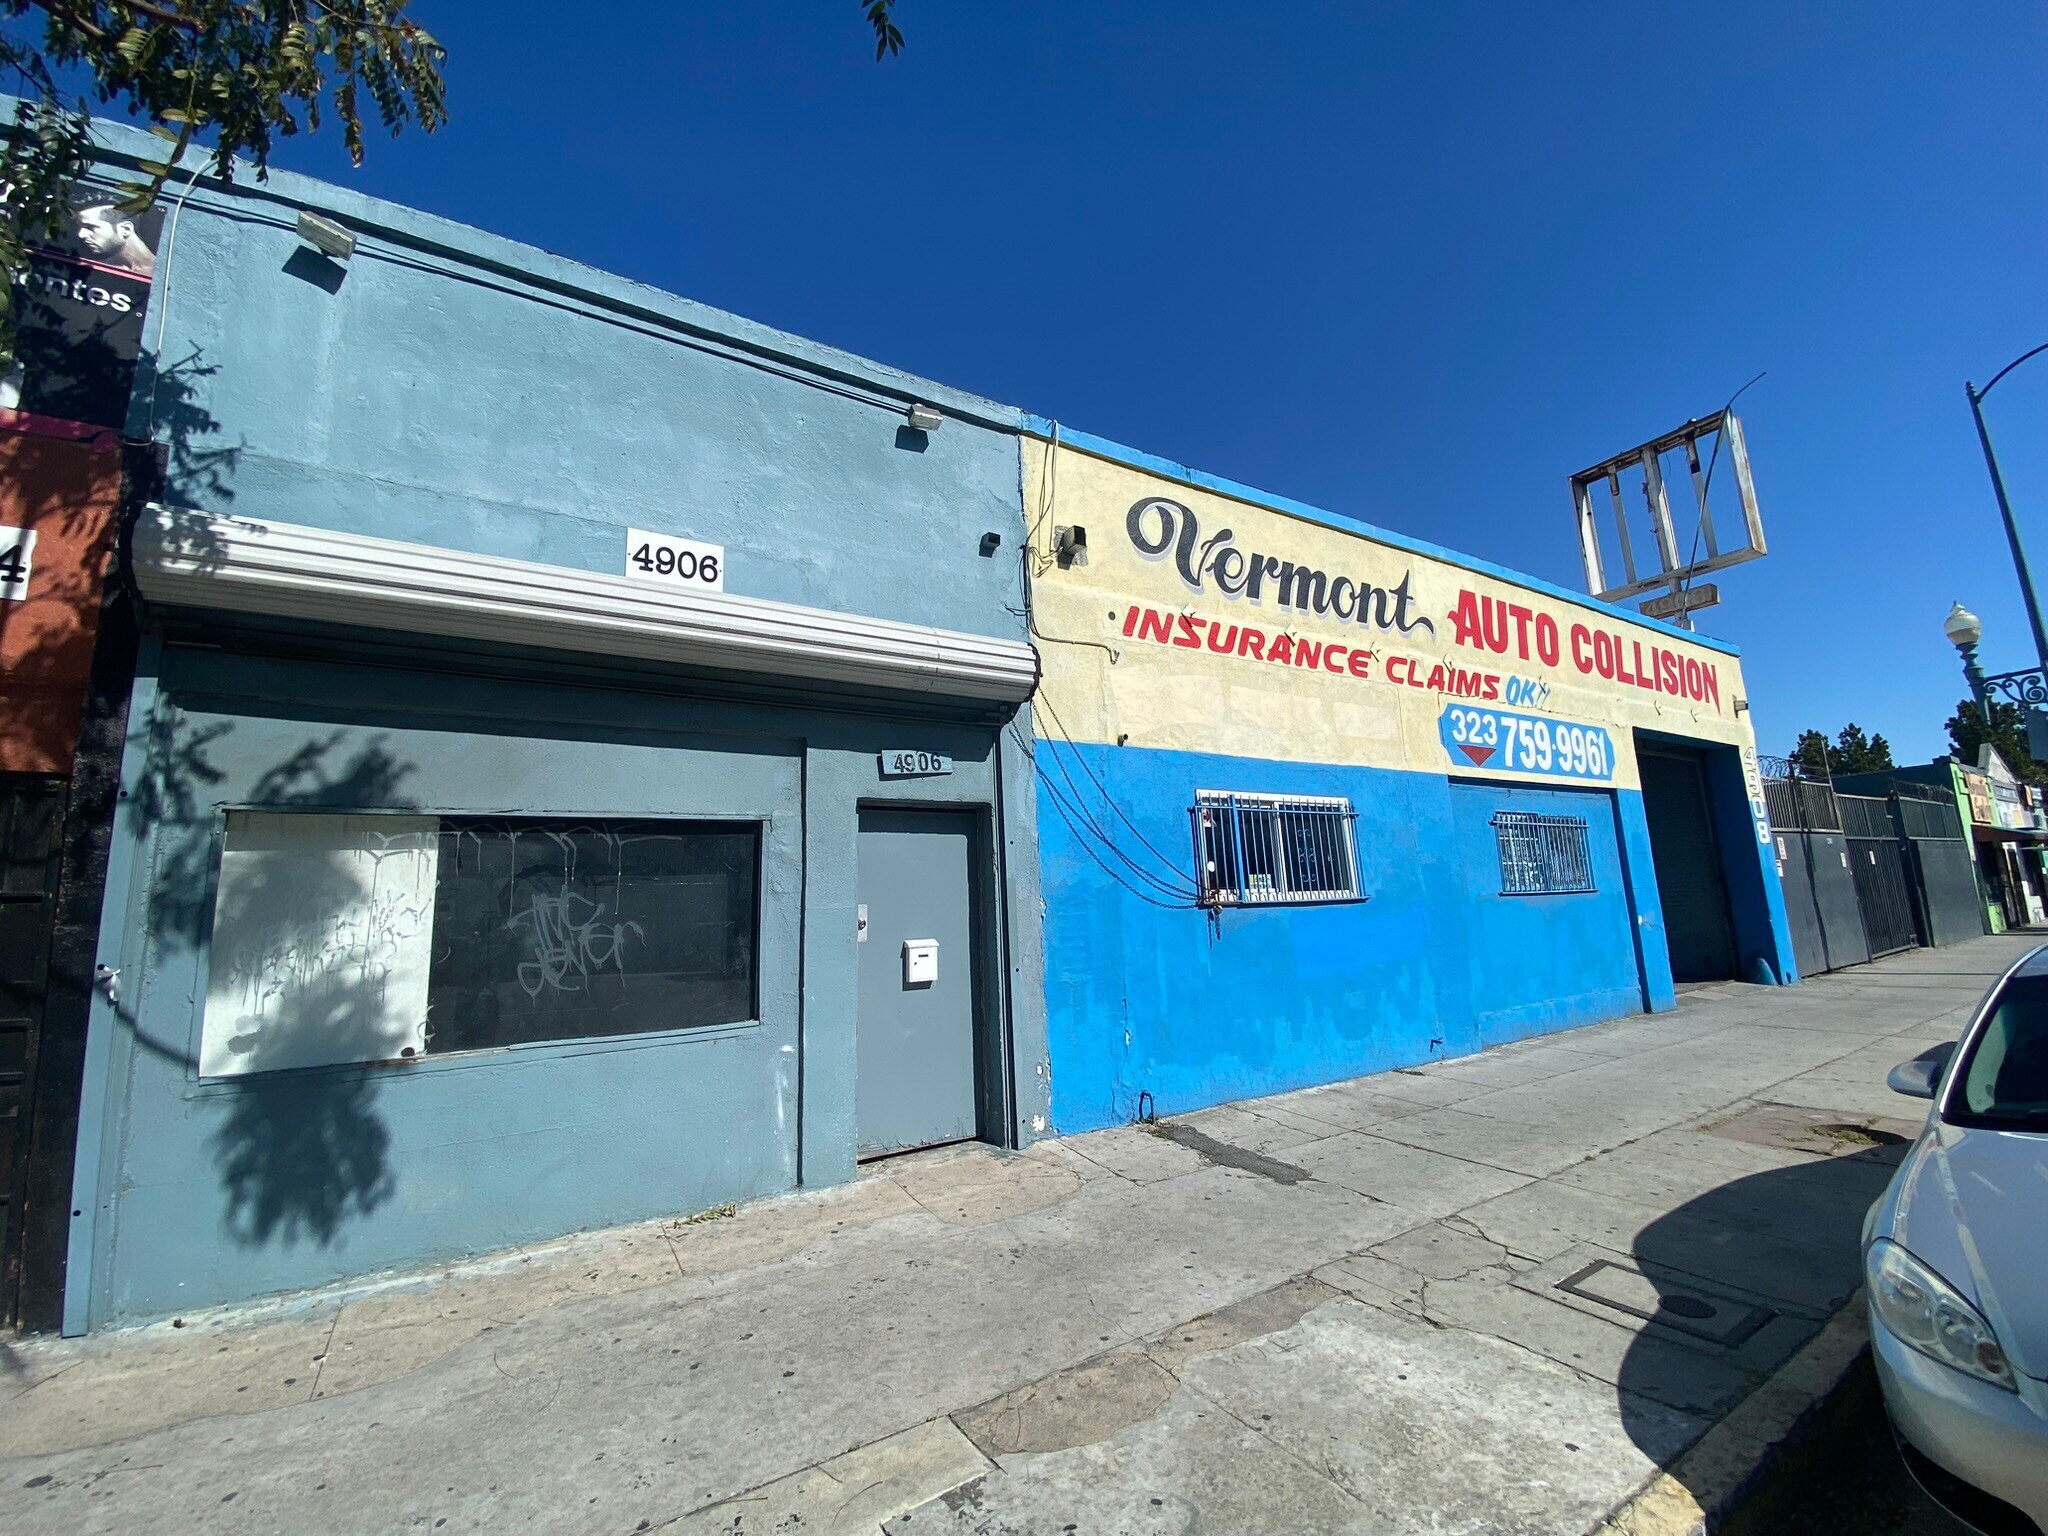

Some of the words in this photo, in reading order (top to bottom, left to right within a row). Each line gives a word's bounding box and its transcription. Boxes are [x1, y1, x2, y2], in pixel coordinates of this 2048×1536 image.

[631, 543, 719, 583] 4906
[1126, 496, 1436, 635] Vermont
[1447, 589, 1560, 667] AUTO
[1571, 623, 1721, 716] COLLISION
[1122, 605, 1372, 679] INSURANCE
[1386, 656, 1500, 700] CLAIMS
[1450, 708, 1498, 746] 323
[894, 752, 942, 773] 4906
[1744, 746, 1771, 844] 4908
